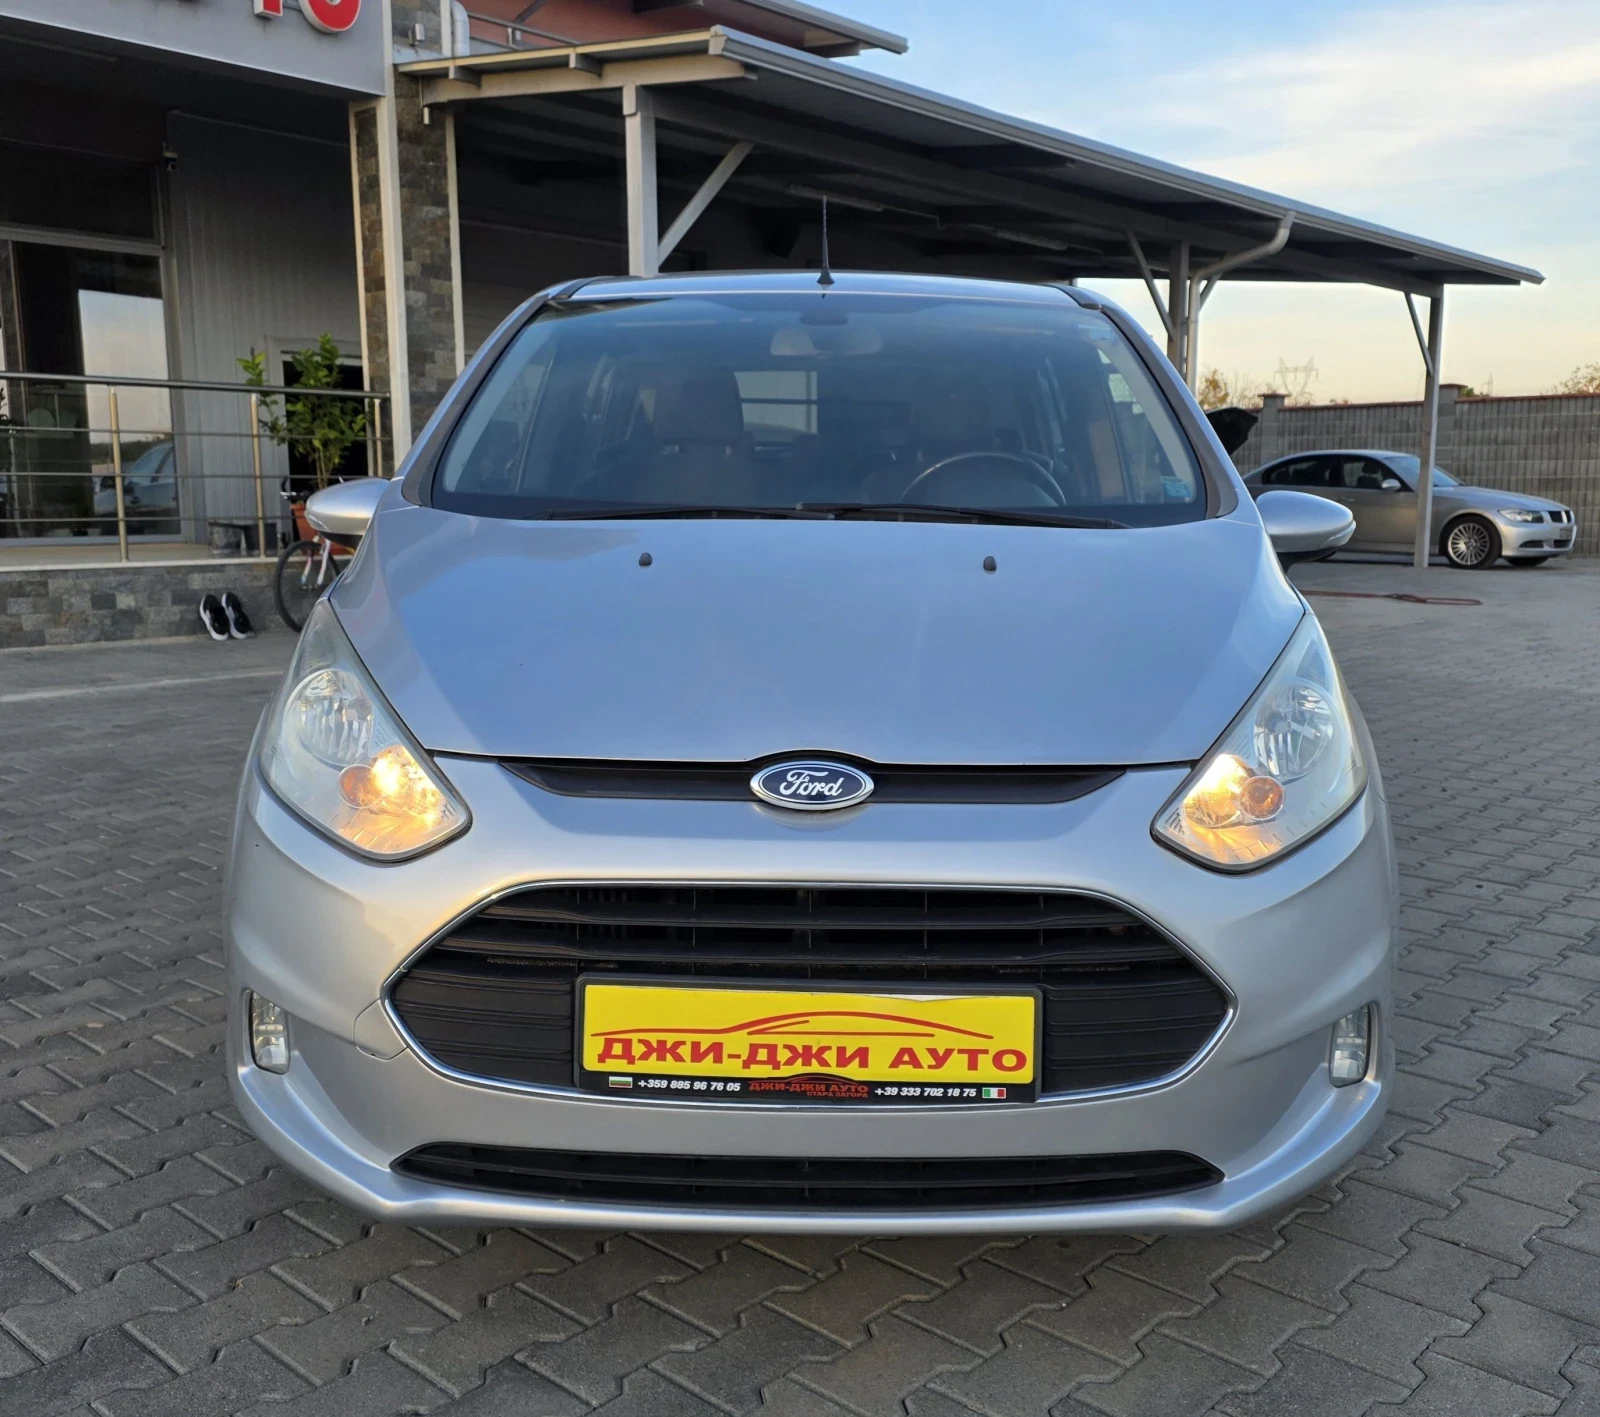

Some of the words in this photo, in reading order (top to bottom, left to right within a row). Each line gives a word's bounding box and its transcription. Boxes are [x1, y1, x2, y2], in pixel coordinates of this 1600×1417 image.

[779, 769, 845, 796] Ford
[597, 1037, 870, 1071] ДЖИ-ДЖИ
[888, 1046, 1028, 1073] АУТО
[638, 1079, 669, 1089] +359
[670, 1080, 692, 1090] 885
[693, 1081, 708, 1091] 96
[710, 1082, 725, 1091] 76
[726, 1082, 742, 1092] 05
[749, 1082, 826, 1092] ДЖИ-ДЖИ
[829, 1084, 869, 1093] АУТО
[874, 1086, 899, 1096] +39
[900, 1087, 922, 1096] 333
[923, 1088, 945, 1097] 702
[947, 1088, 961, 1097] 18
[962, 1088, 977, 1097] 75
